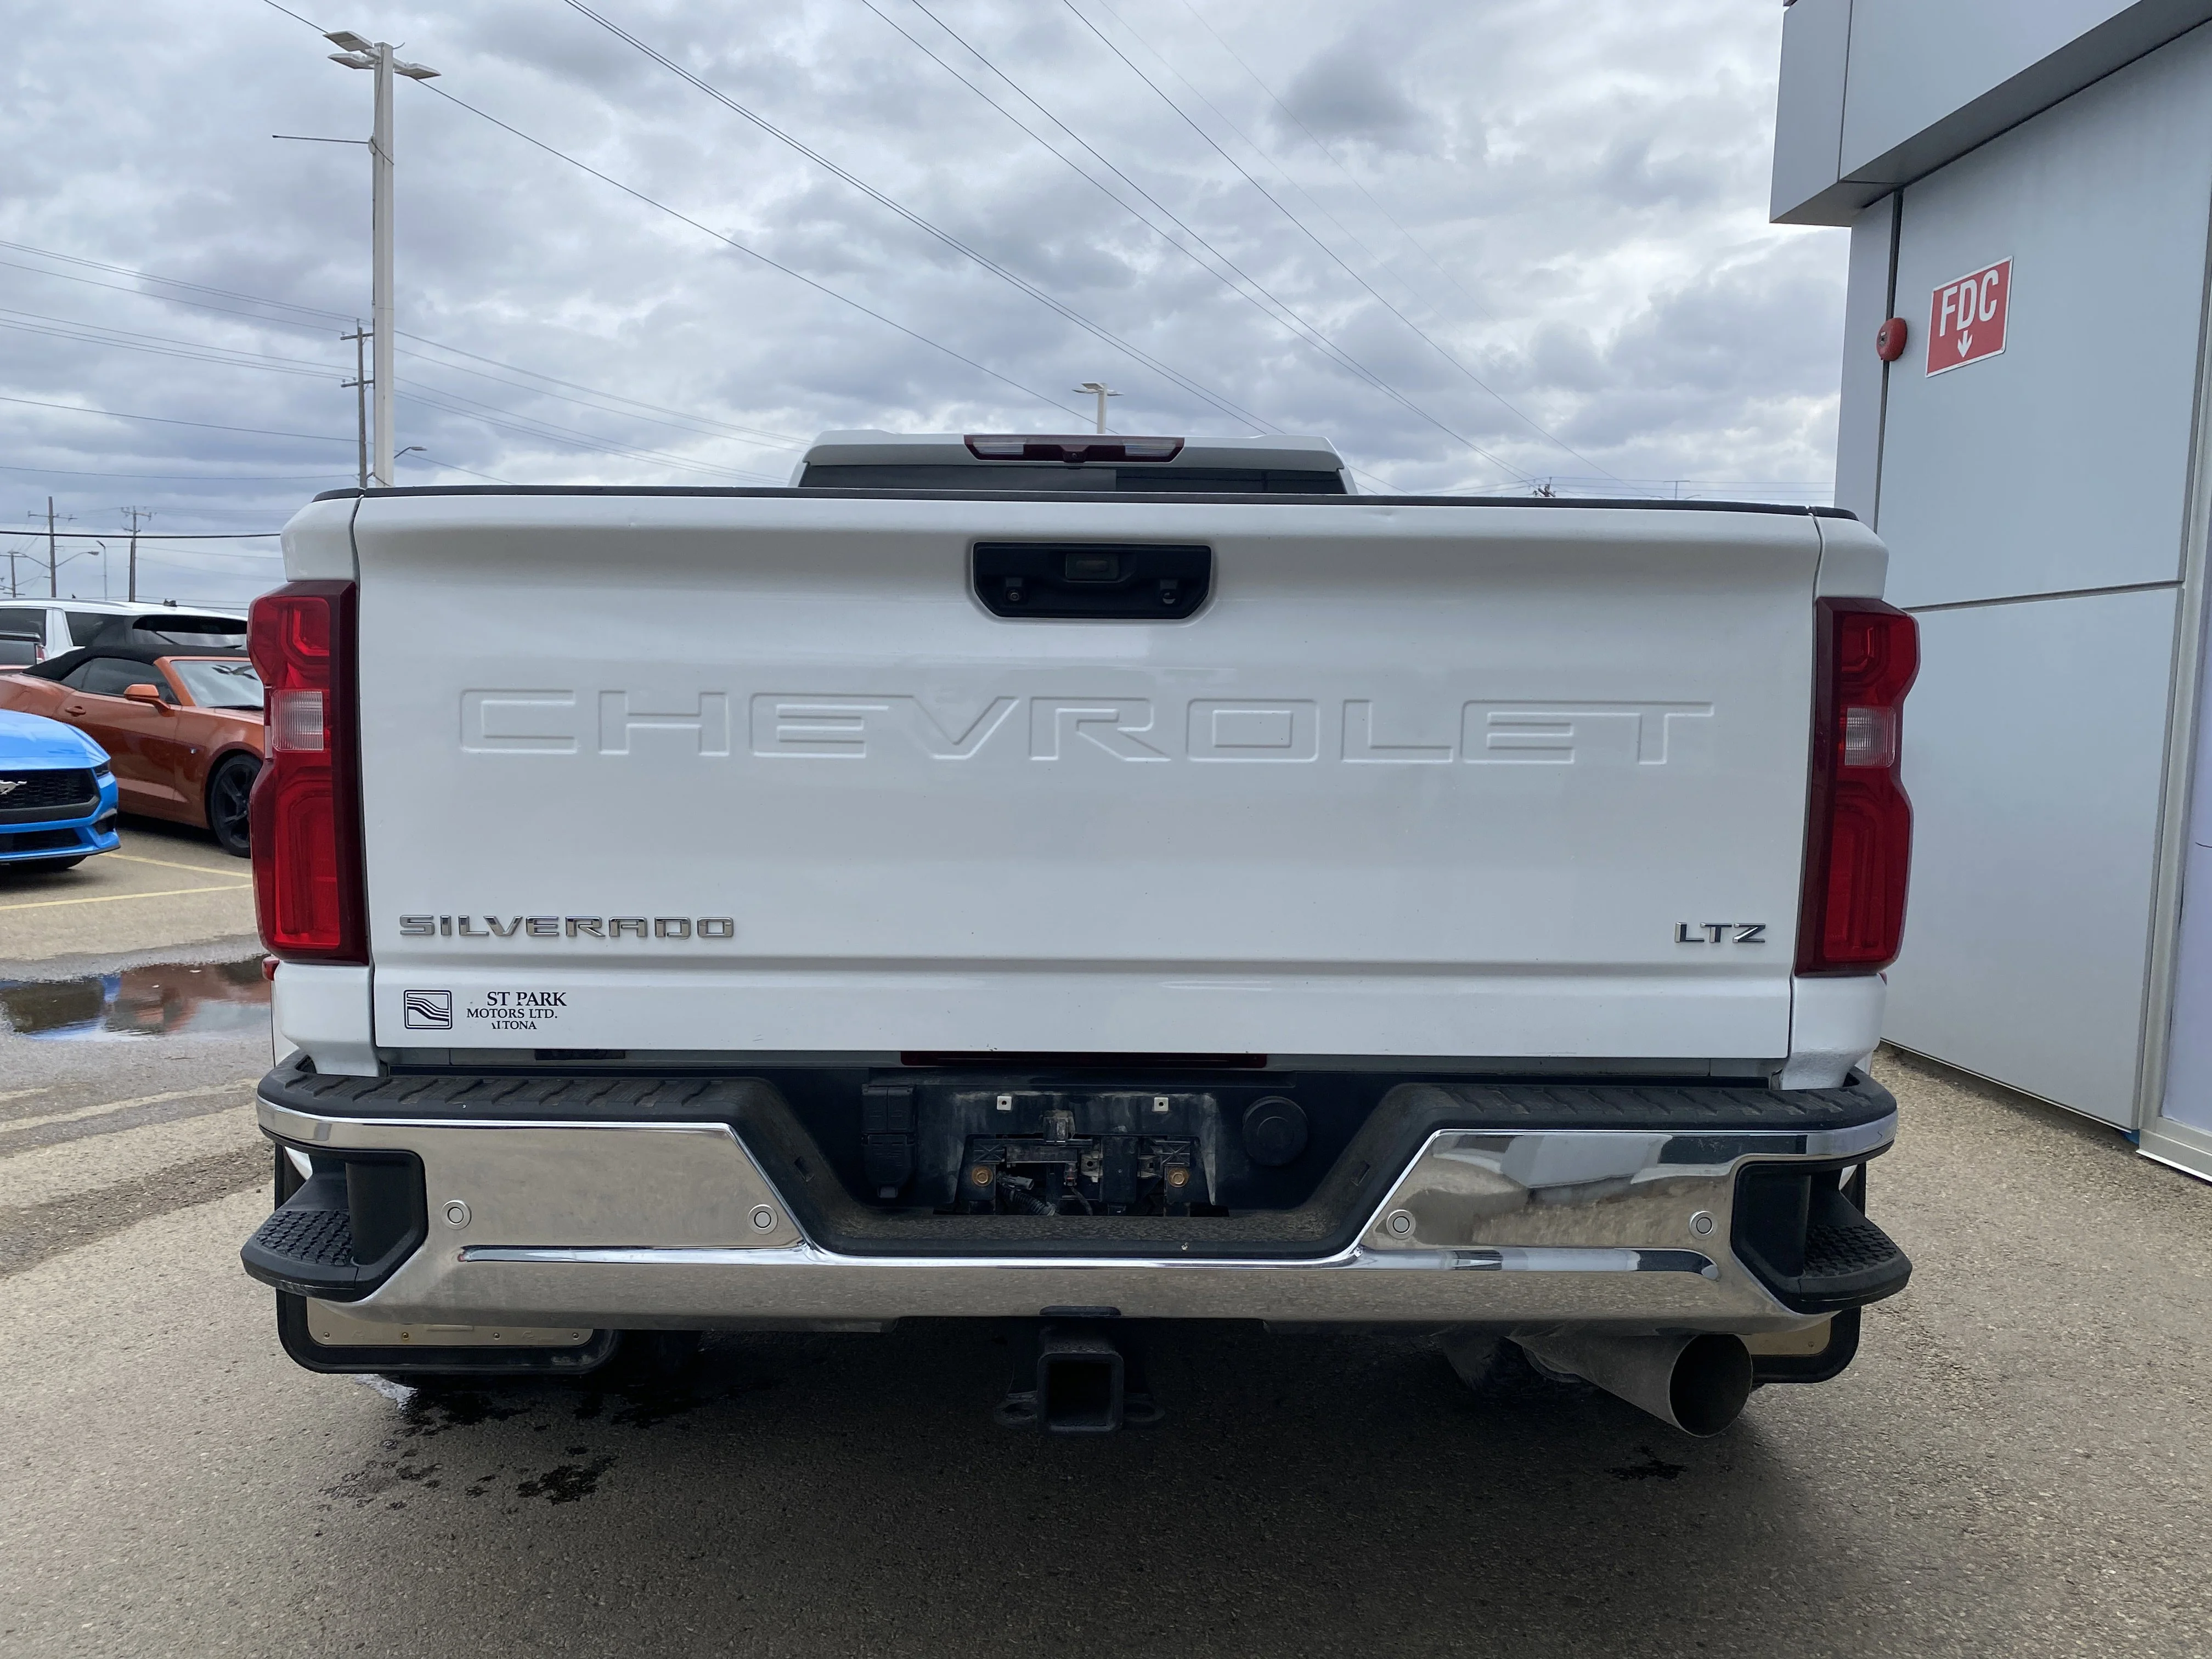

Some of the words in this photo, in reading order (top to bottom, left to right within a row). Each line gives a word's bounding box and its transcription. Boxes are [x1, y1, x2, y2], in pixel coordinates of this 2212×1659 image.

[1939, 269, 1999, 337] FDC
[459, 689, 1714, 765] CHEVROLET
[399, 914, 734, 938] SILVERADO
[1674, 922, 1766, 943] LTZ
[516, 991, 567, 1006] PARK
[466, 1008, 525, 1019] MOTORS
[528, 1008, 558, 1019] LTD.
